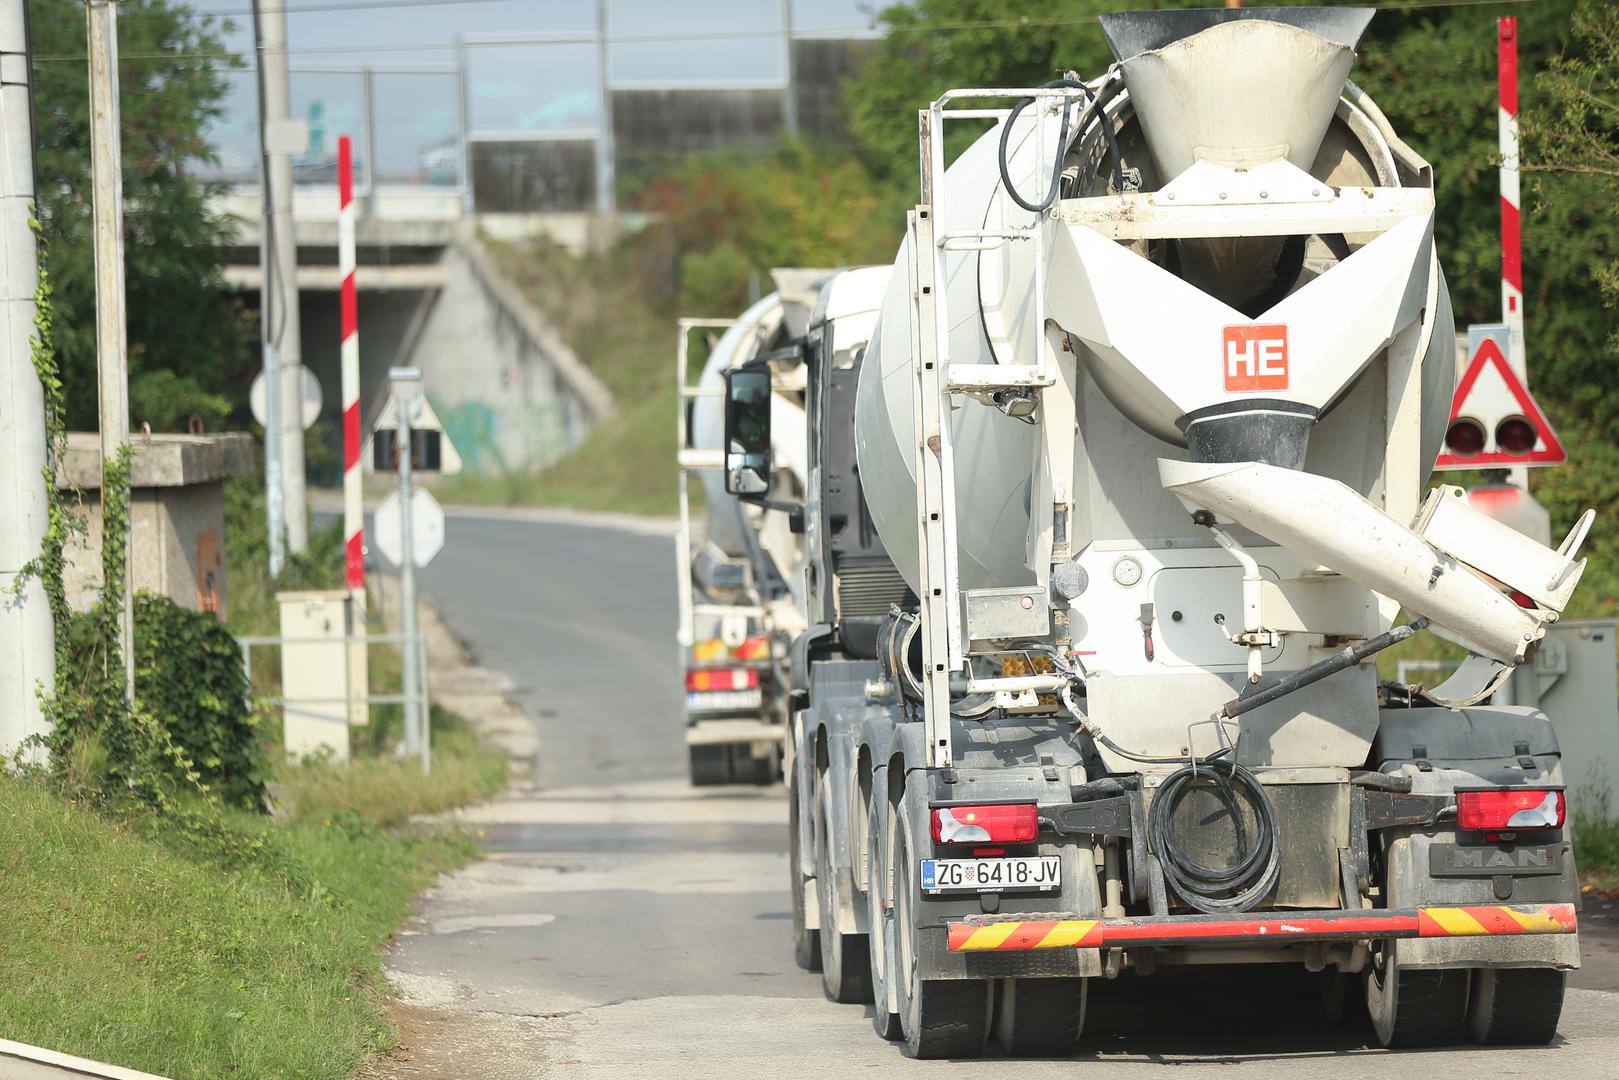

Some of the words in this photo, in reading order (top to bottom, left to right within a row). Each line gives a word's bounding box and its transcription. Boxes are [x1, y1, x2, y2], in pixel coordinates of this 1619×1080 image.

[1227, 339, 1285, 377] HE
[1454, 849, 1547, 868] MAN
[923, 877, 934, 885] HR
[937, 863, 963, 885] ZG
